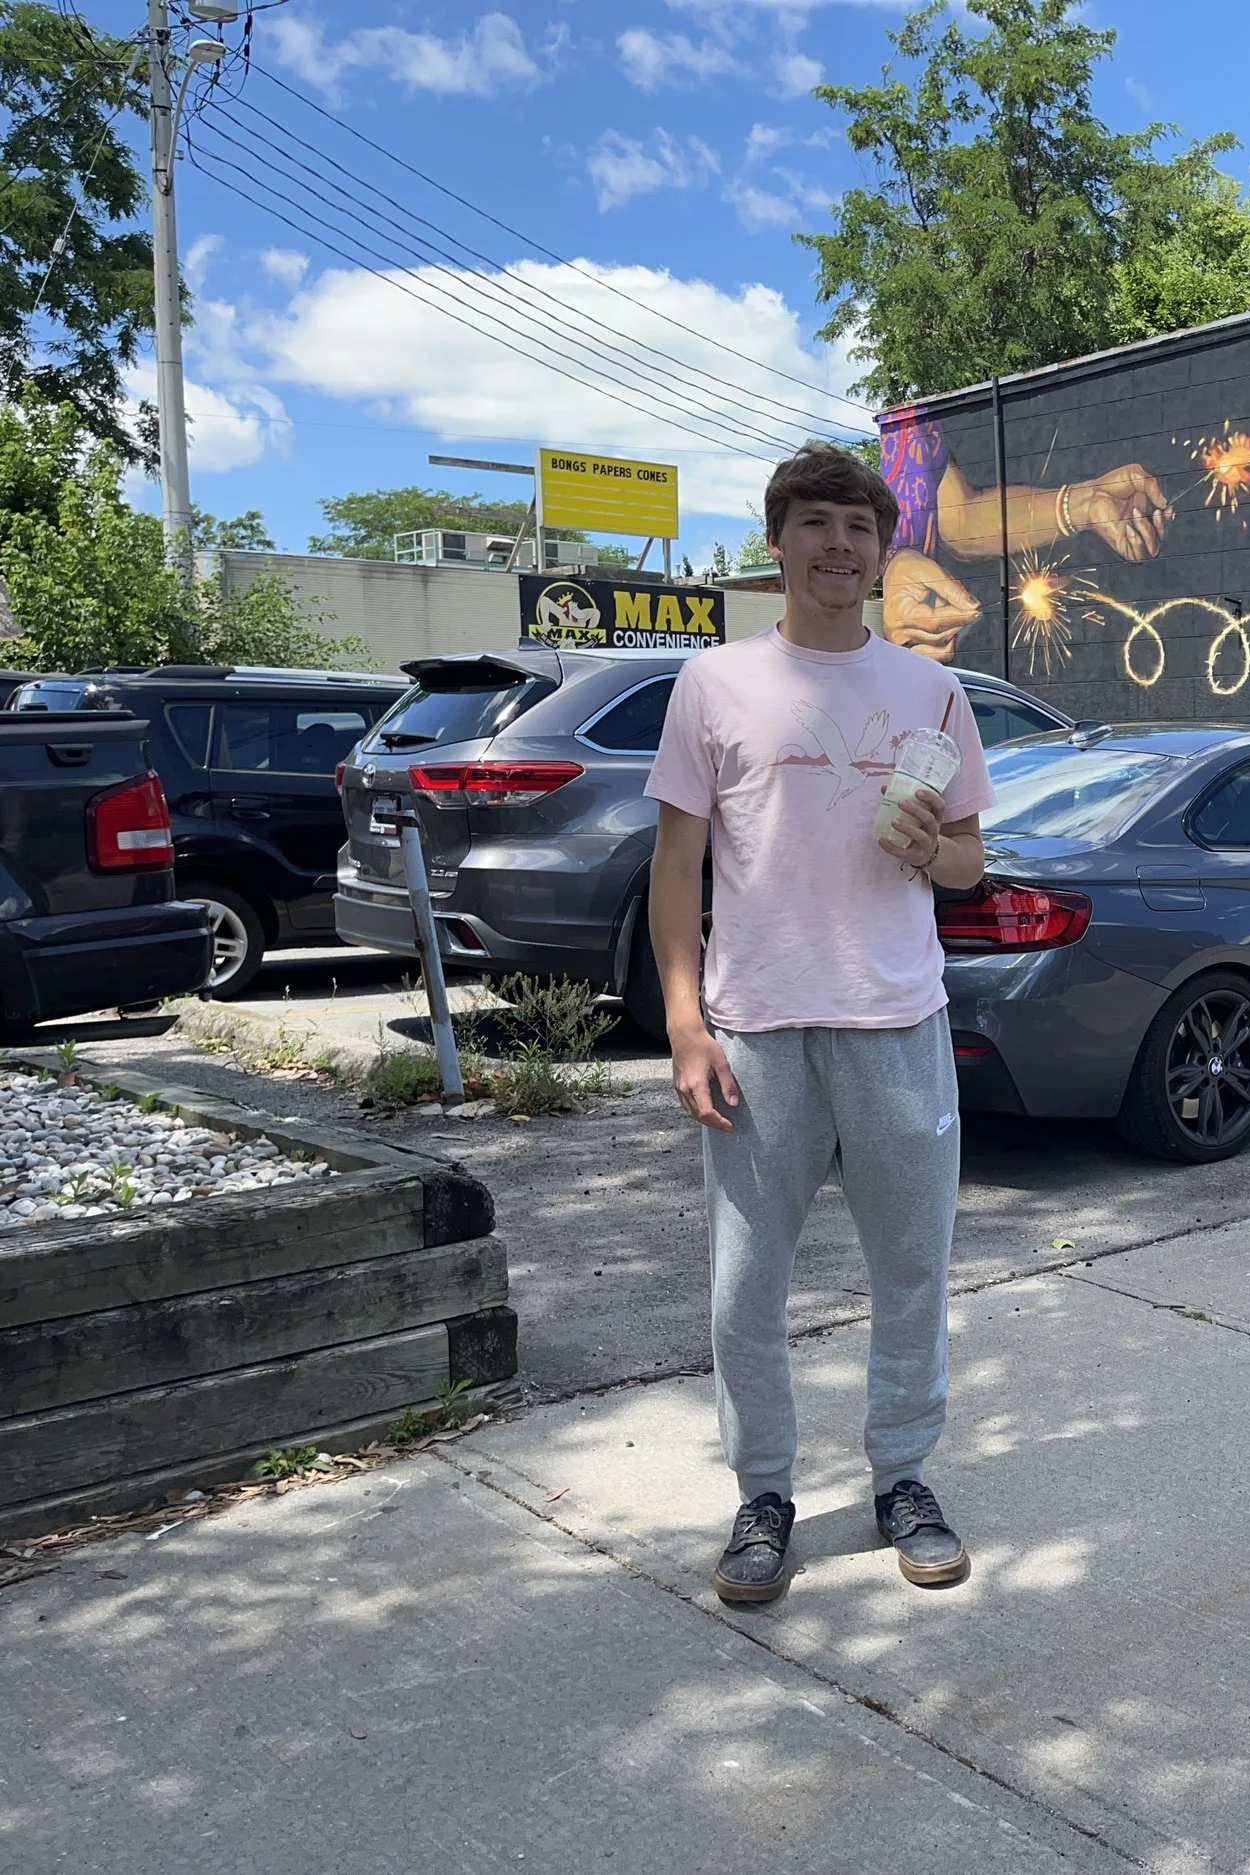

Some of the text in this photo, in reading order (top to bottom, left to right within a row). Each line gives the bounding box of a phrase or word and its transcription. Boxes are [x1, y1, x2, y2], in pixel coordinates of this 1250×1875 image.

[551, 457, 668, 483] BONGS PAPERS CONES
[613, 590, 717, 634] MAX
[547, 627, 590, 641] MAX
